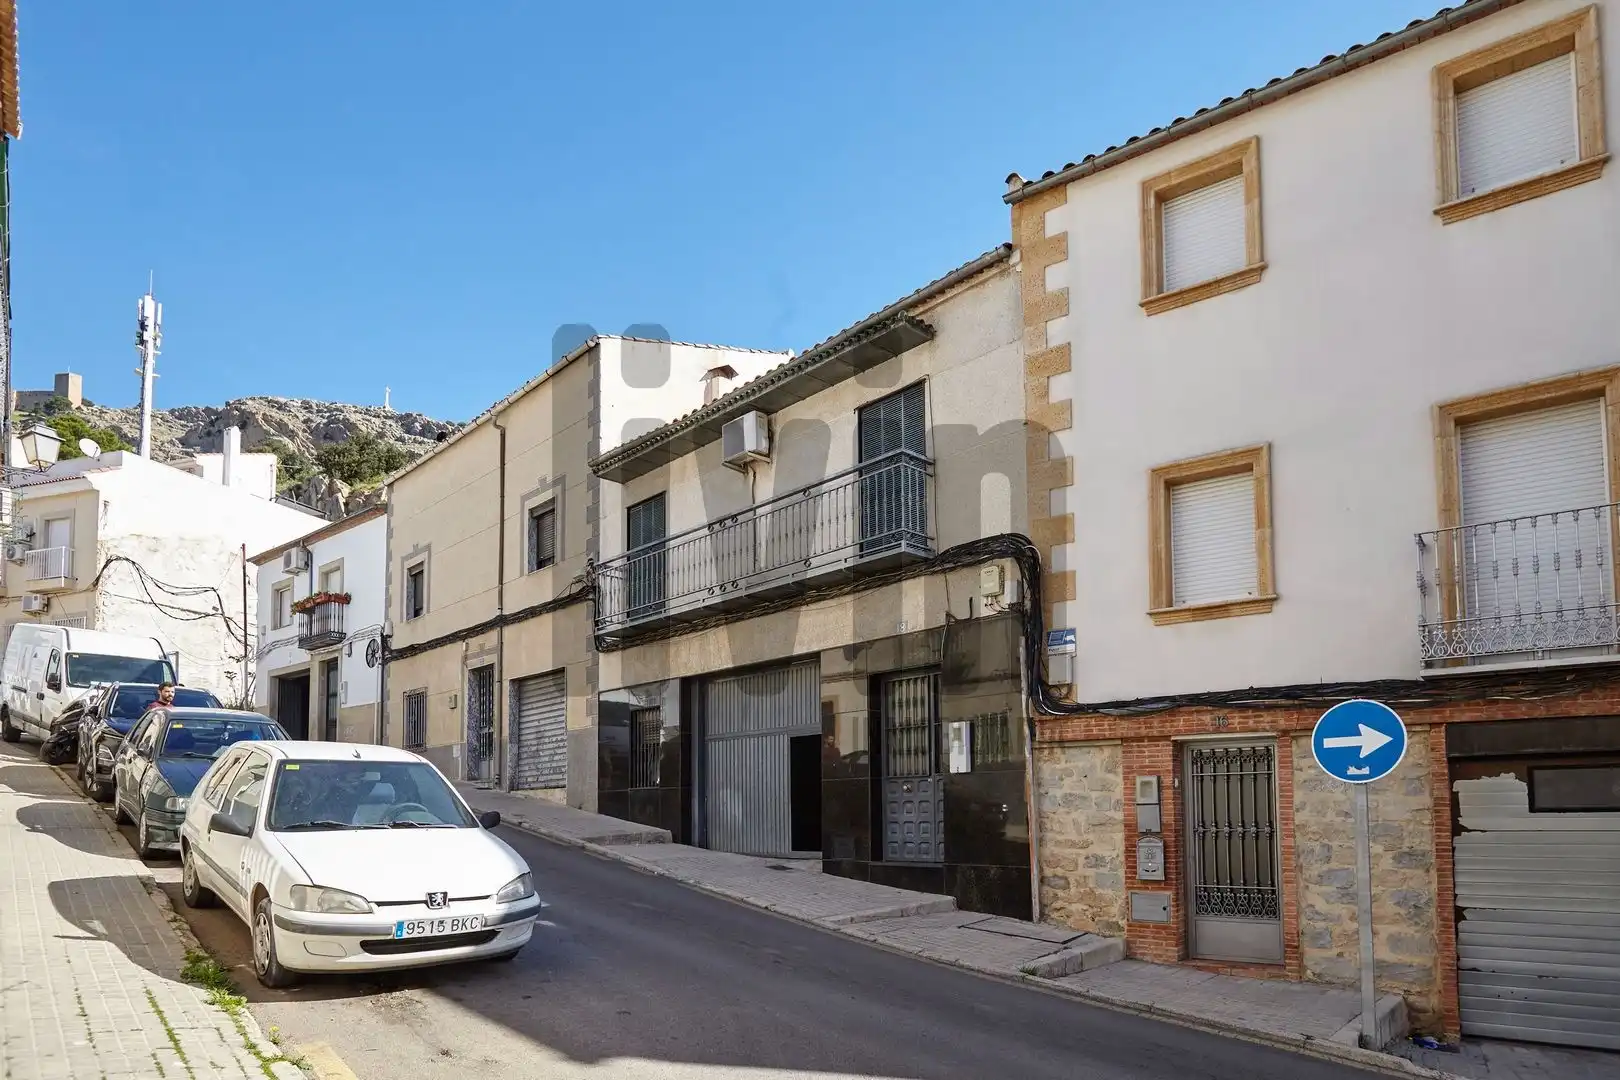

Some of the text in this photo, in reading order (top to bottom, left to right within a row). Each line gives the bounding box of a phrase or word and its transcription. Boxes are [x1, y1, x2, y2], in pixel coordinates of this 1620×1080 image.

[1216, 715, 1229, 728] 16
[406, 916, 479, 935] 9515 BKC
